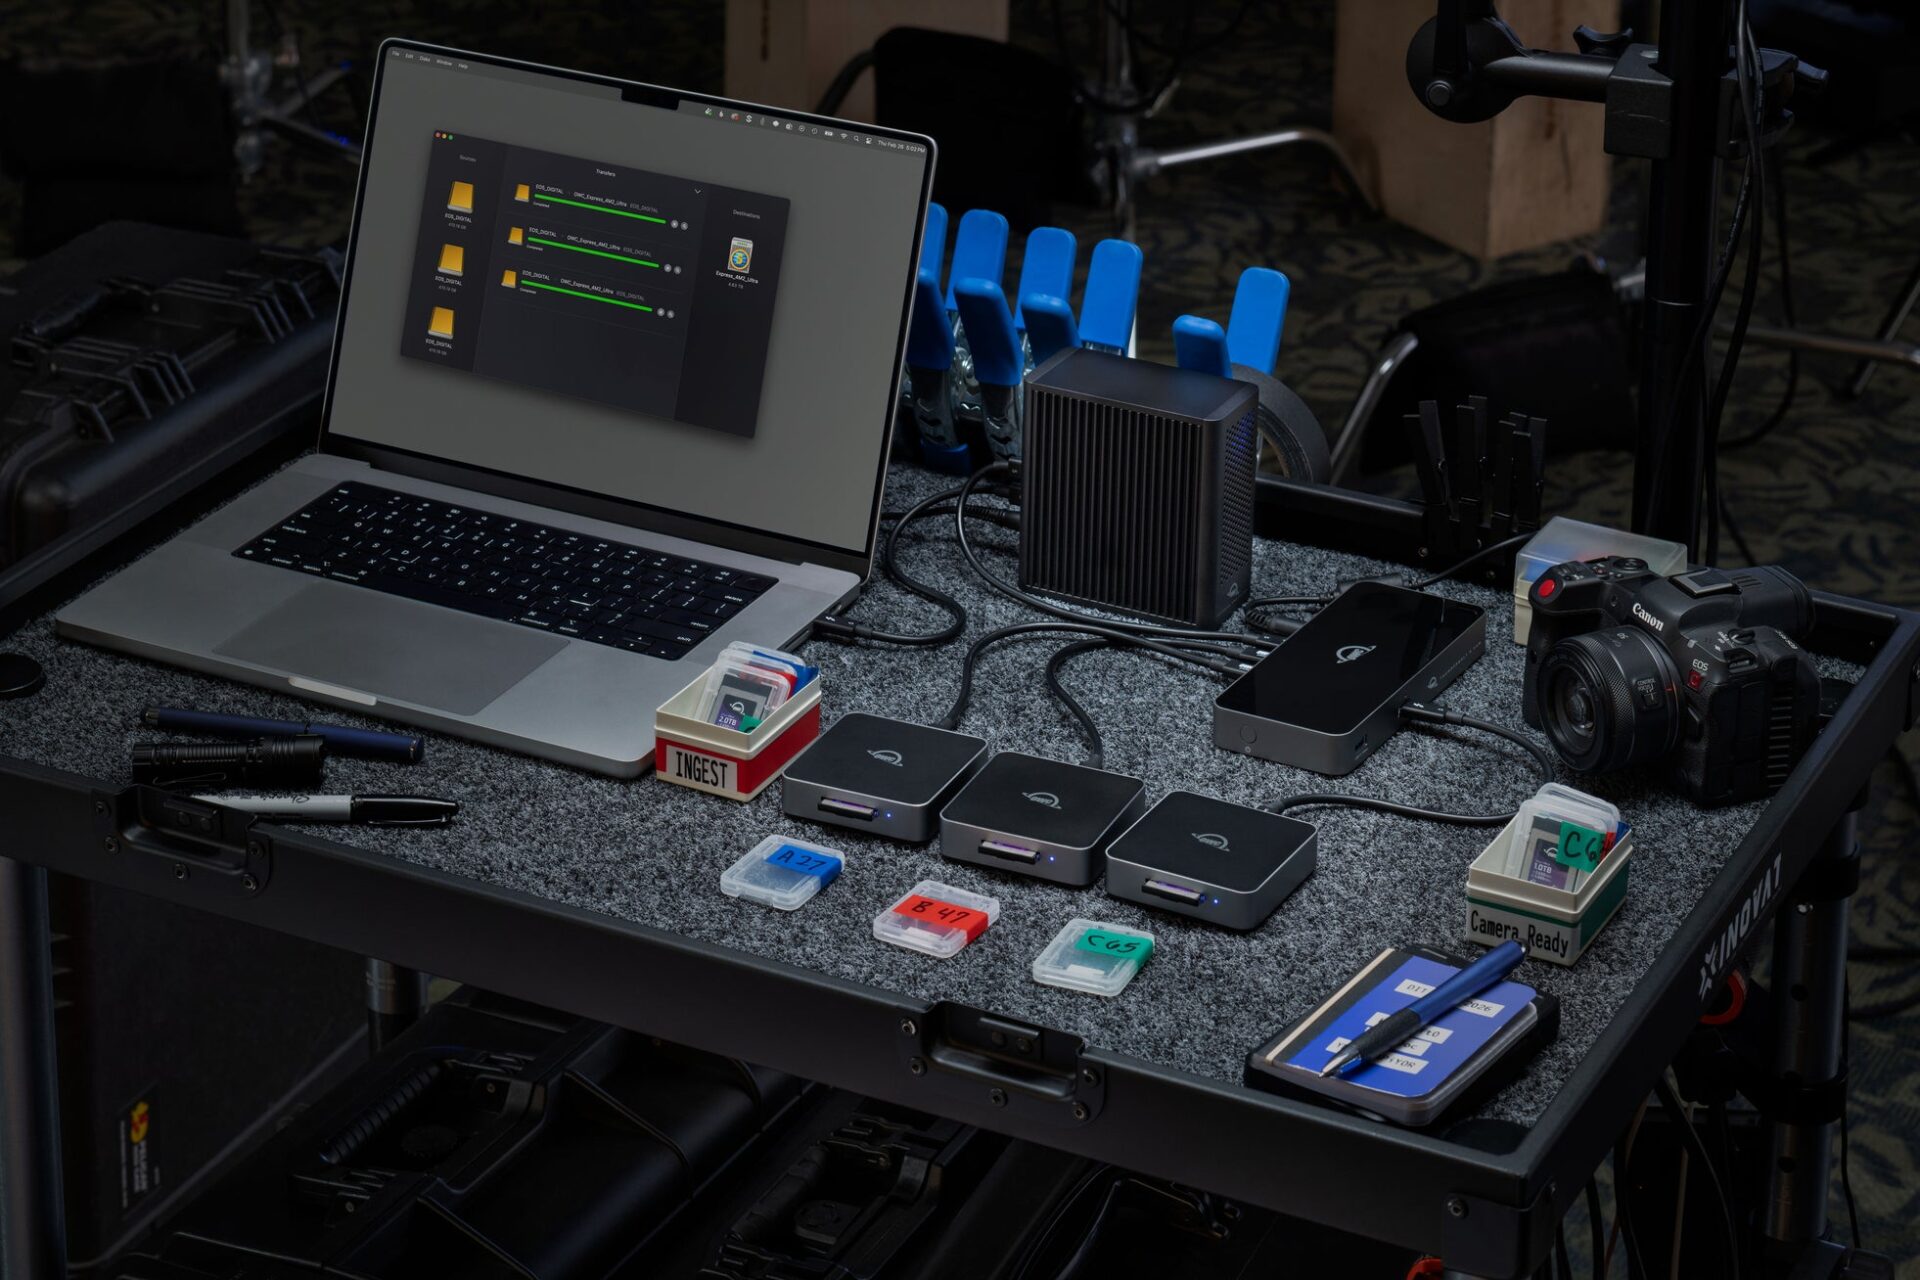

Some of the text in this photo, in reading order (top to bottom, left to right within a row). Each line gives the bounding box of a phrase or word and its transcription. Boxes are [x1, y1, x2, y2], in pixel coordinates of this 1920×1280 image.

[1632, 602, 1664, 632] Canon
[1692, 658, 1709, 671] EOS
[719, 715, 737, 726] 2.0TB
[676, 752, 727, 788] INGEST
[938, 908, 970, 923] 47
[1471, 910, 1569, 958] Camera Ready
